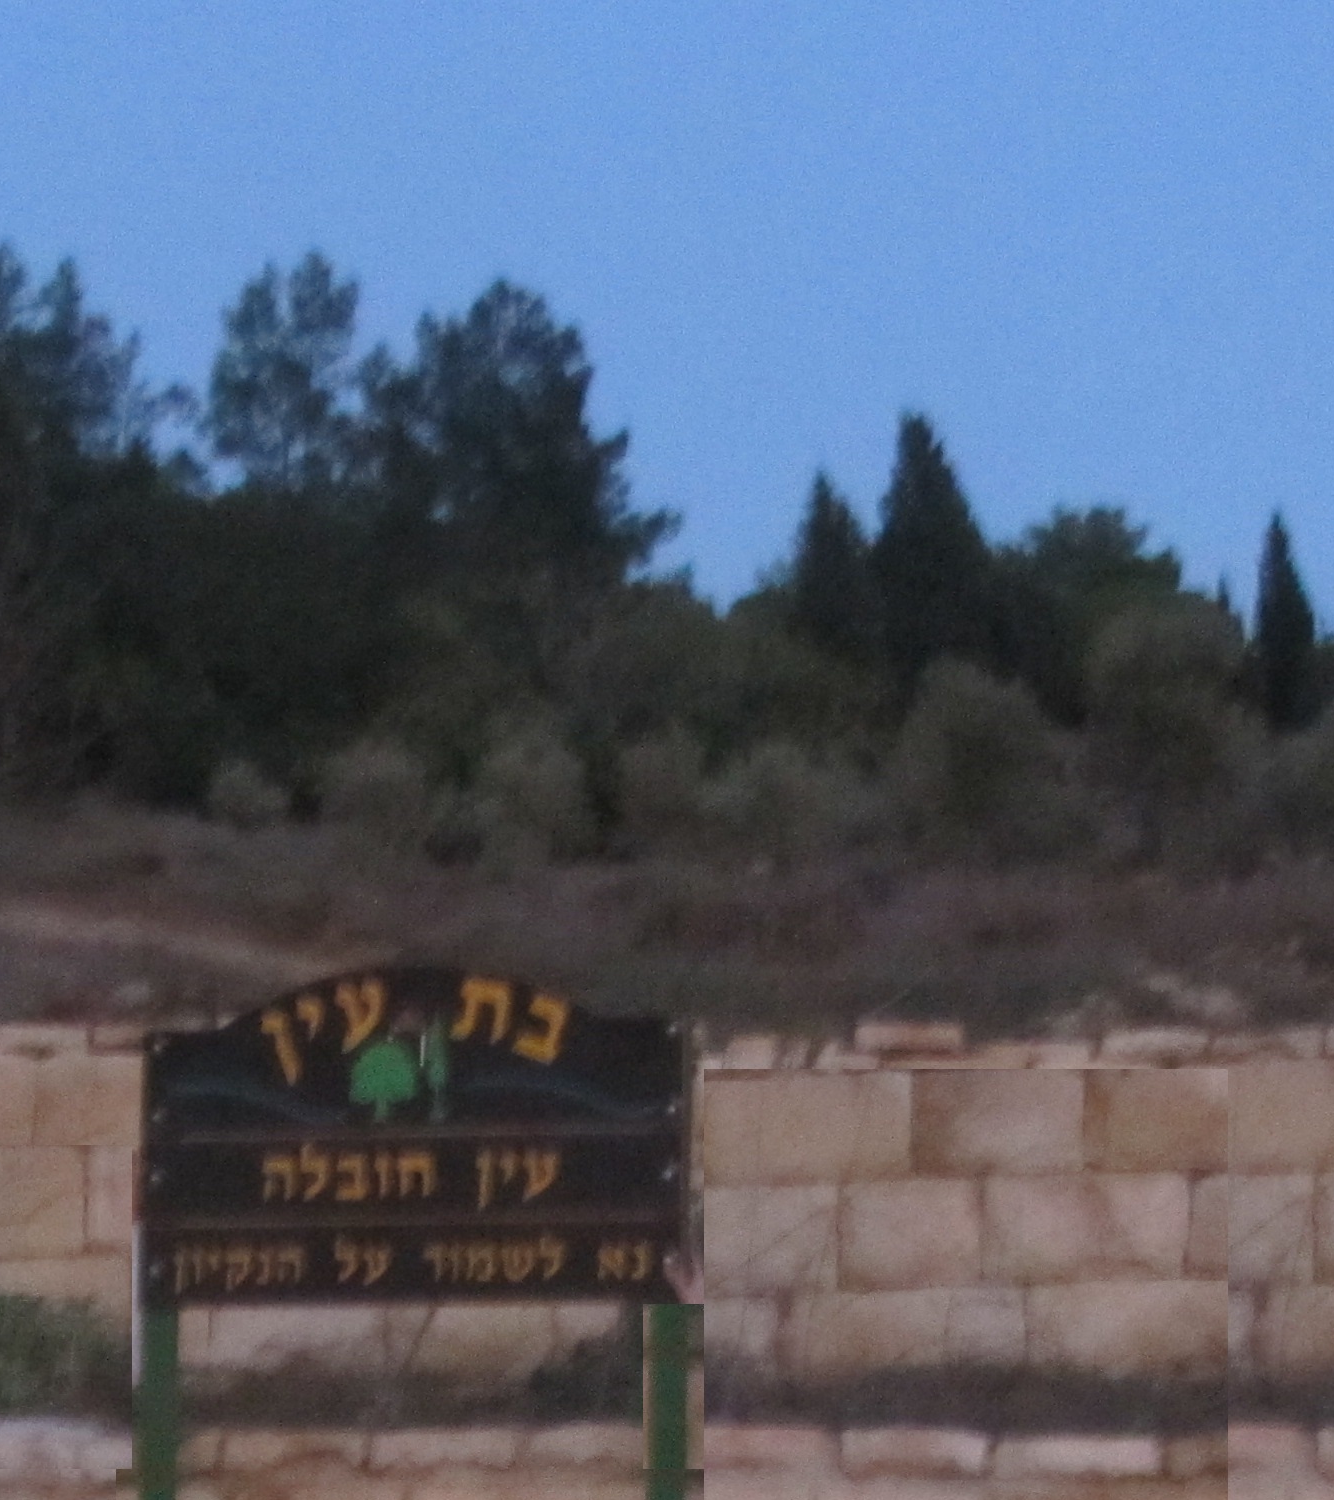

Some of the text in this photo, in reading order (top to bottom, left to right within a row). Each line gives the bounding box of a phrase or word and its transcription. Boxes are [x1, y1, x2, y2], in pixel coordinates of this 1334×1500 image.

[261, 977, 569, 1087] בת עין
[263, 1143, 561, 1211] עין חובלה
[173, 1234, 651, 1296] נא לשמור על הנקיון
